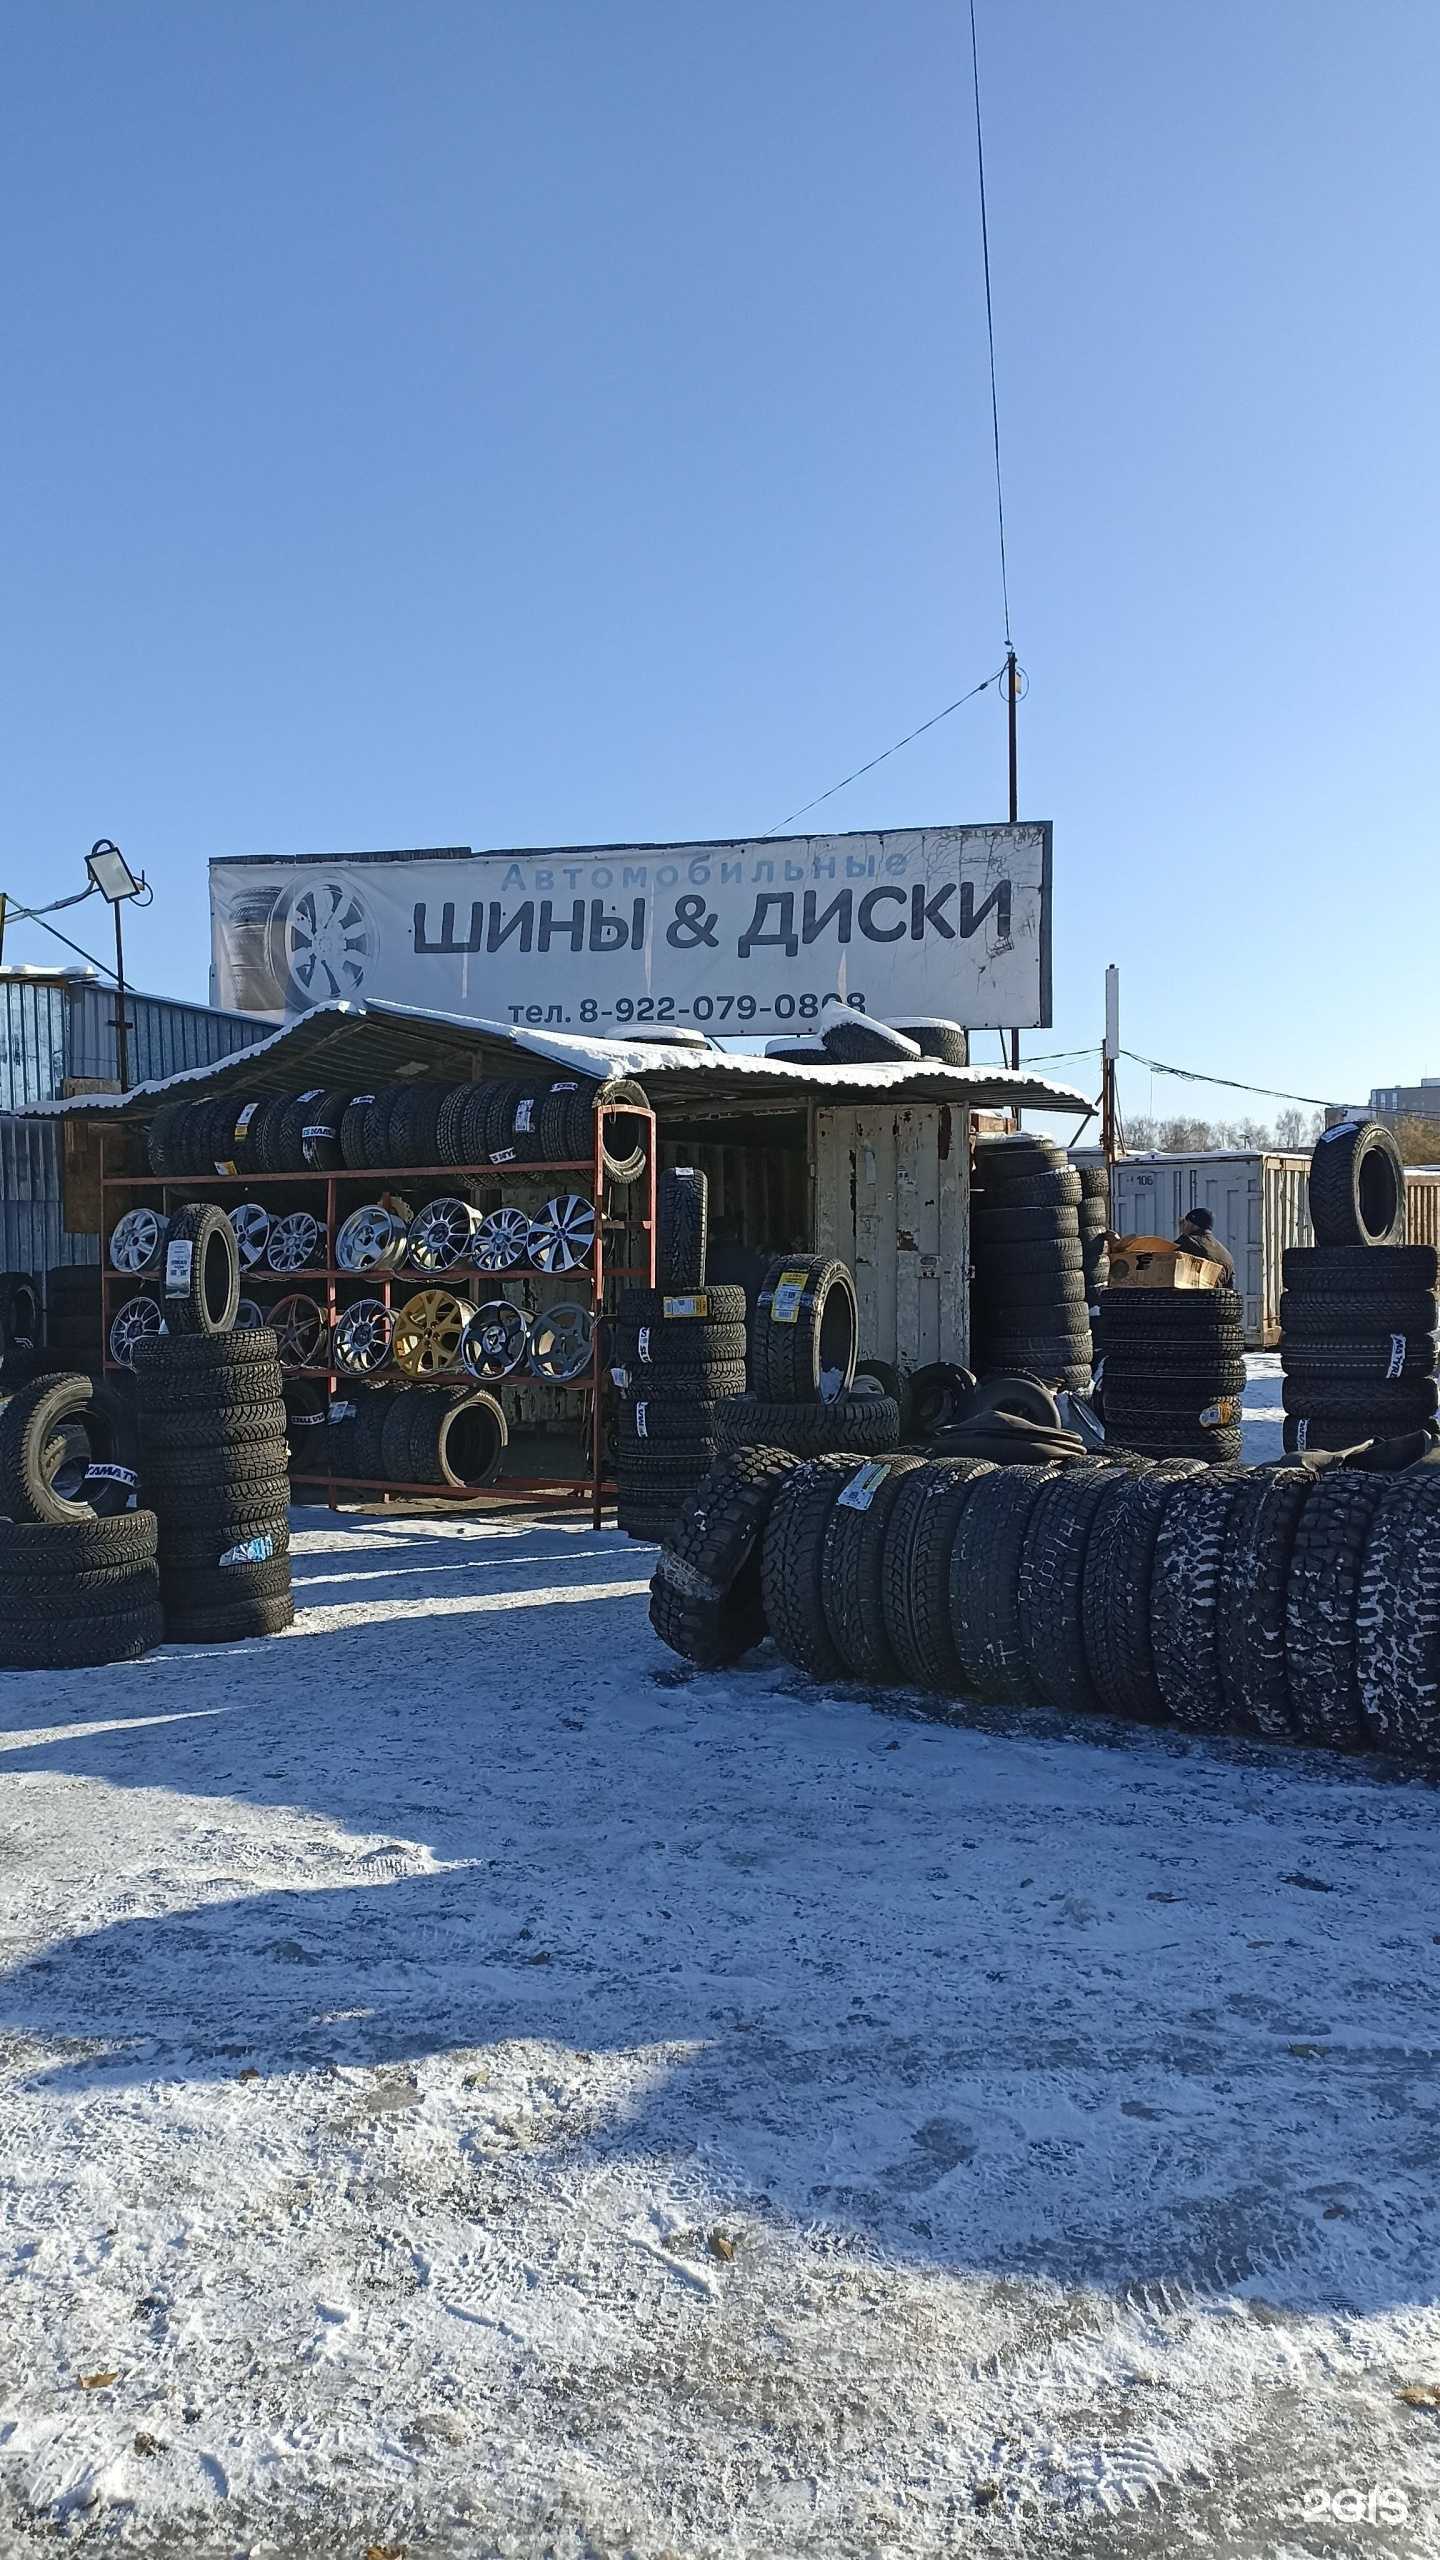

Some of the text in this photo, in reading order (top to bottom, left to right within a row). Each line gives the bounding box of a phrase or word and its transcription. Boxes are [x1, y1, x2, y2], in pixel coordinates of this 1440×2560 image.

[501, 853, 911, 892] Автомобильные
[413, 879, 1013, 958] ШИНЫ & ДИСКИ
[508, 1004, 571, 1023] тел.
